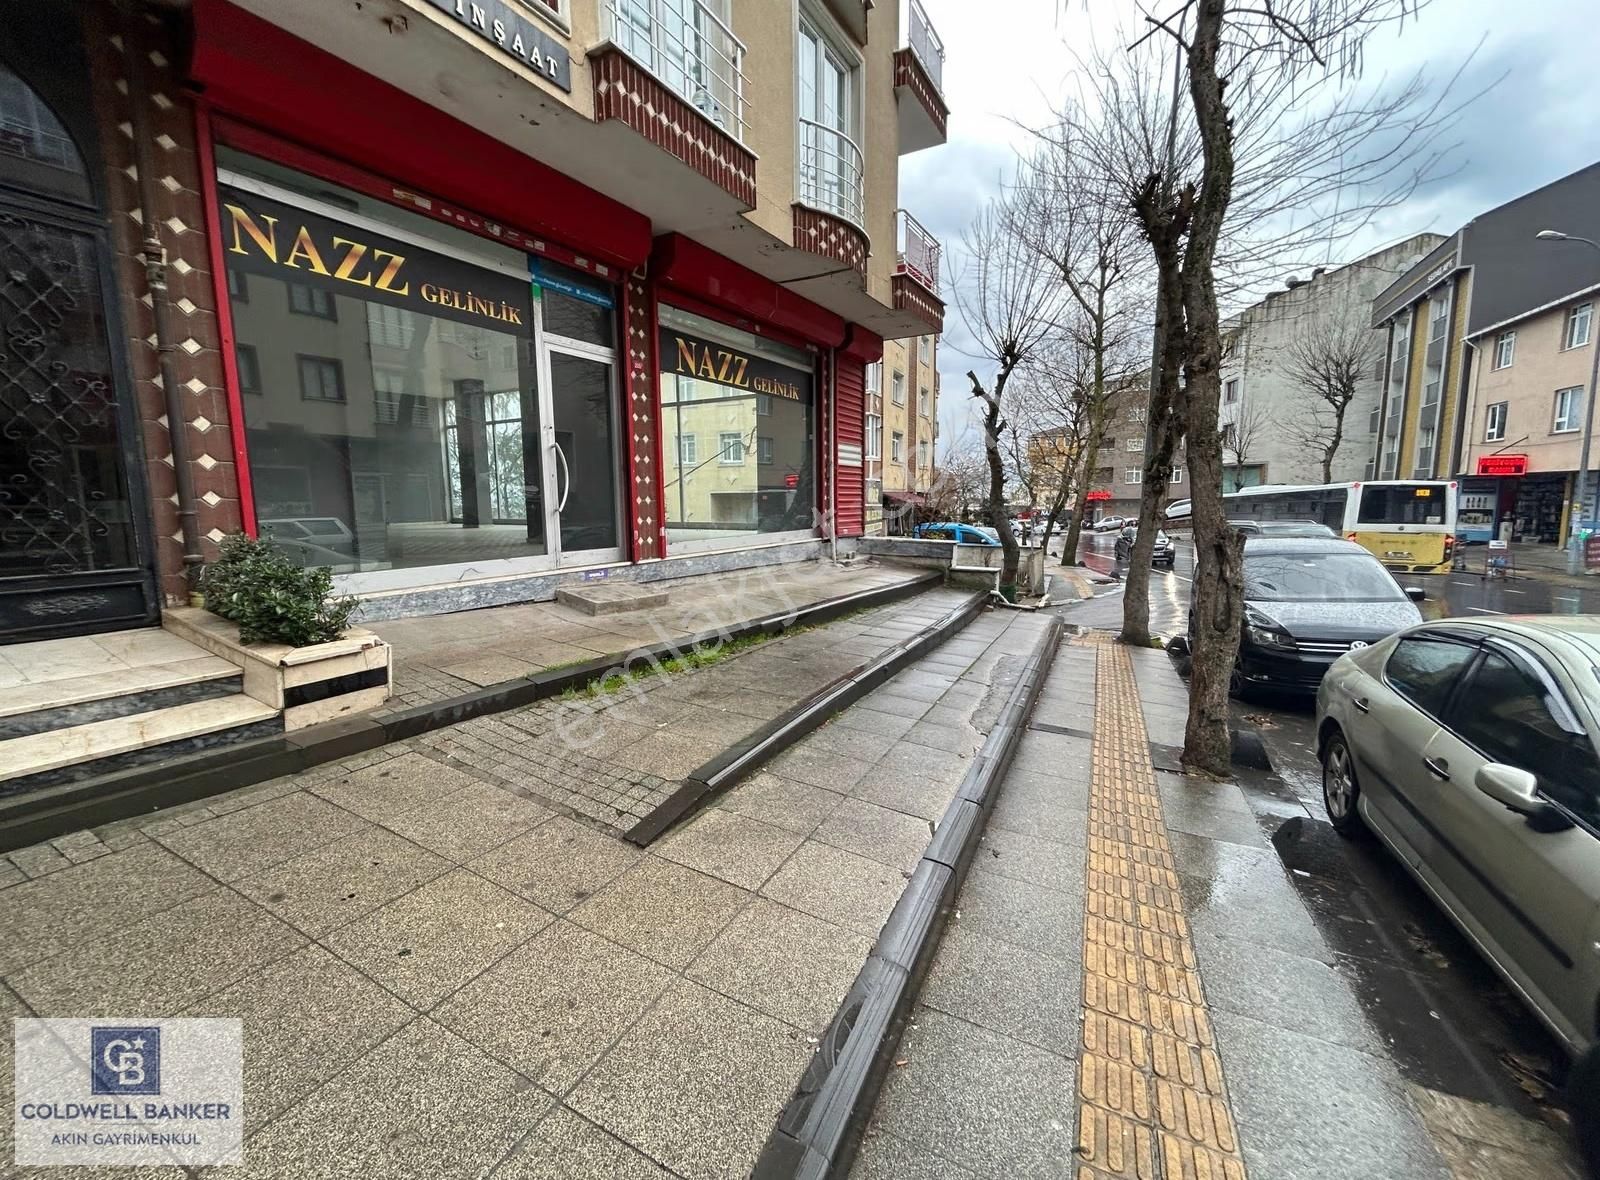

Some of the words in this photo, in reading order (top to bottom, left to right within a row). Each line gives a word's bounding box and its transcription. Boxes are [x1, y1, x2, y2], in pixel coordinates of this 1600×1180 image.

[223, 203, 409, 296] NAZZ
[420, 282, 523, 325] GELİNLİK
[675, 337, 750, 388] NAZZ
[753, 376, 800, 401] GELİNLİK
